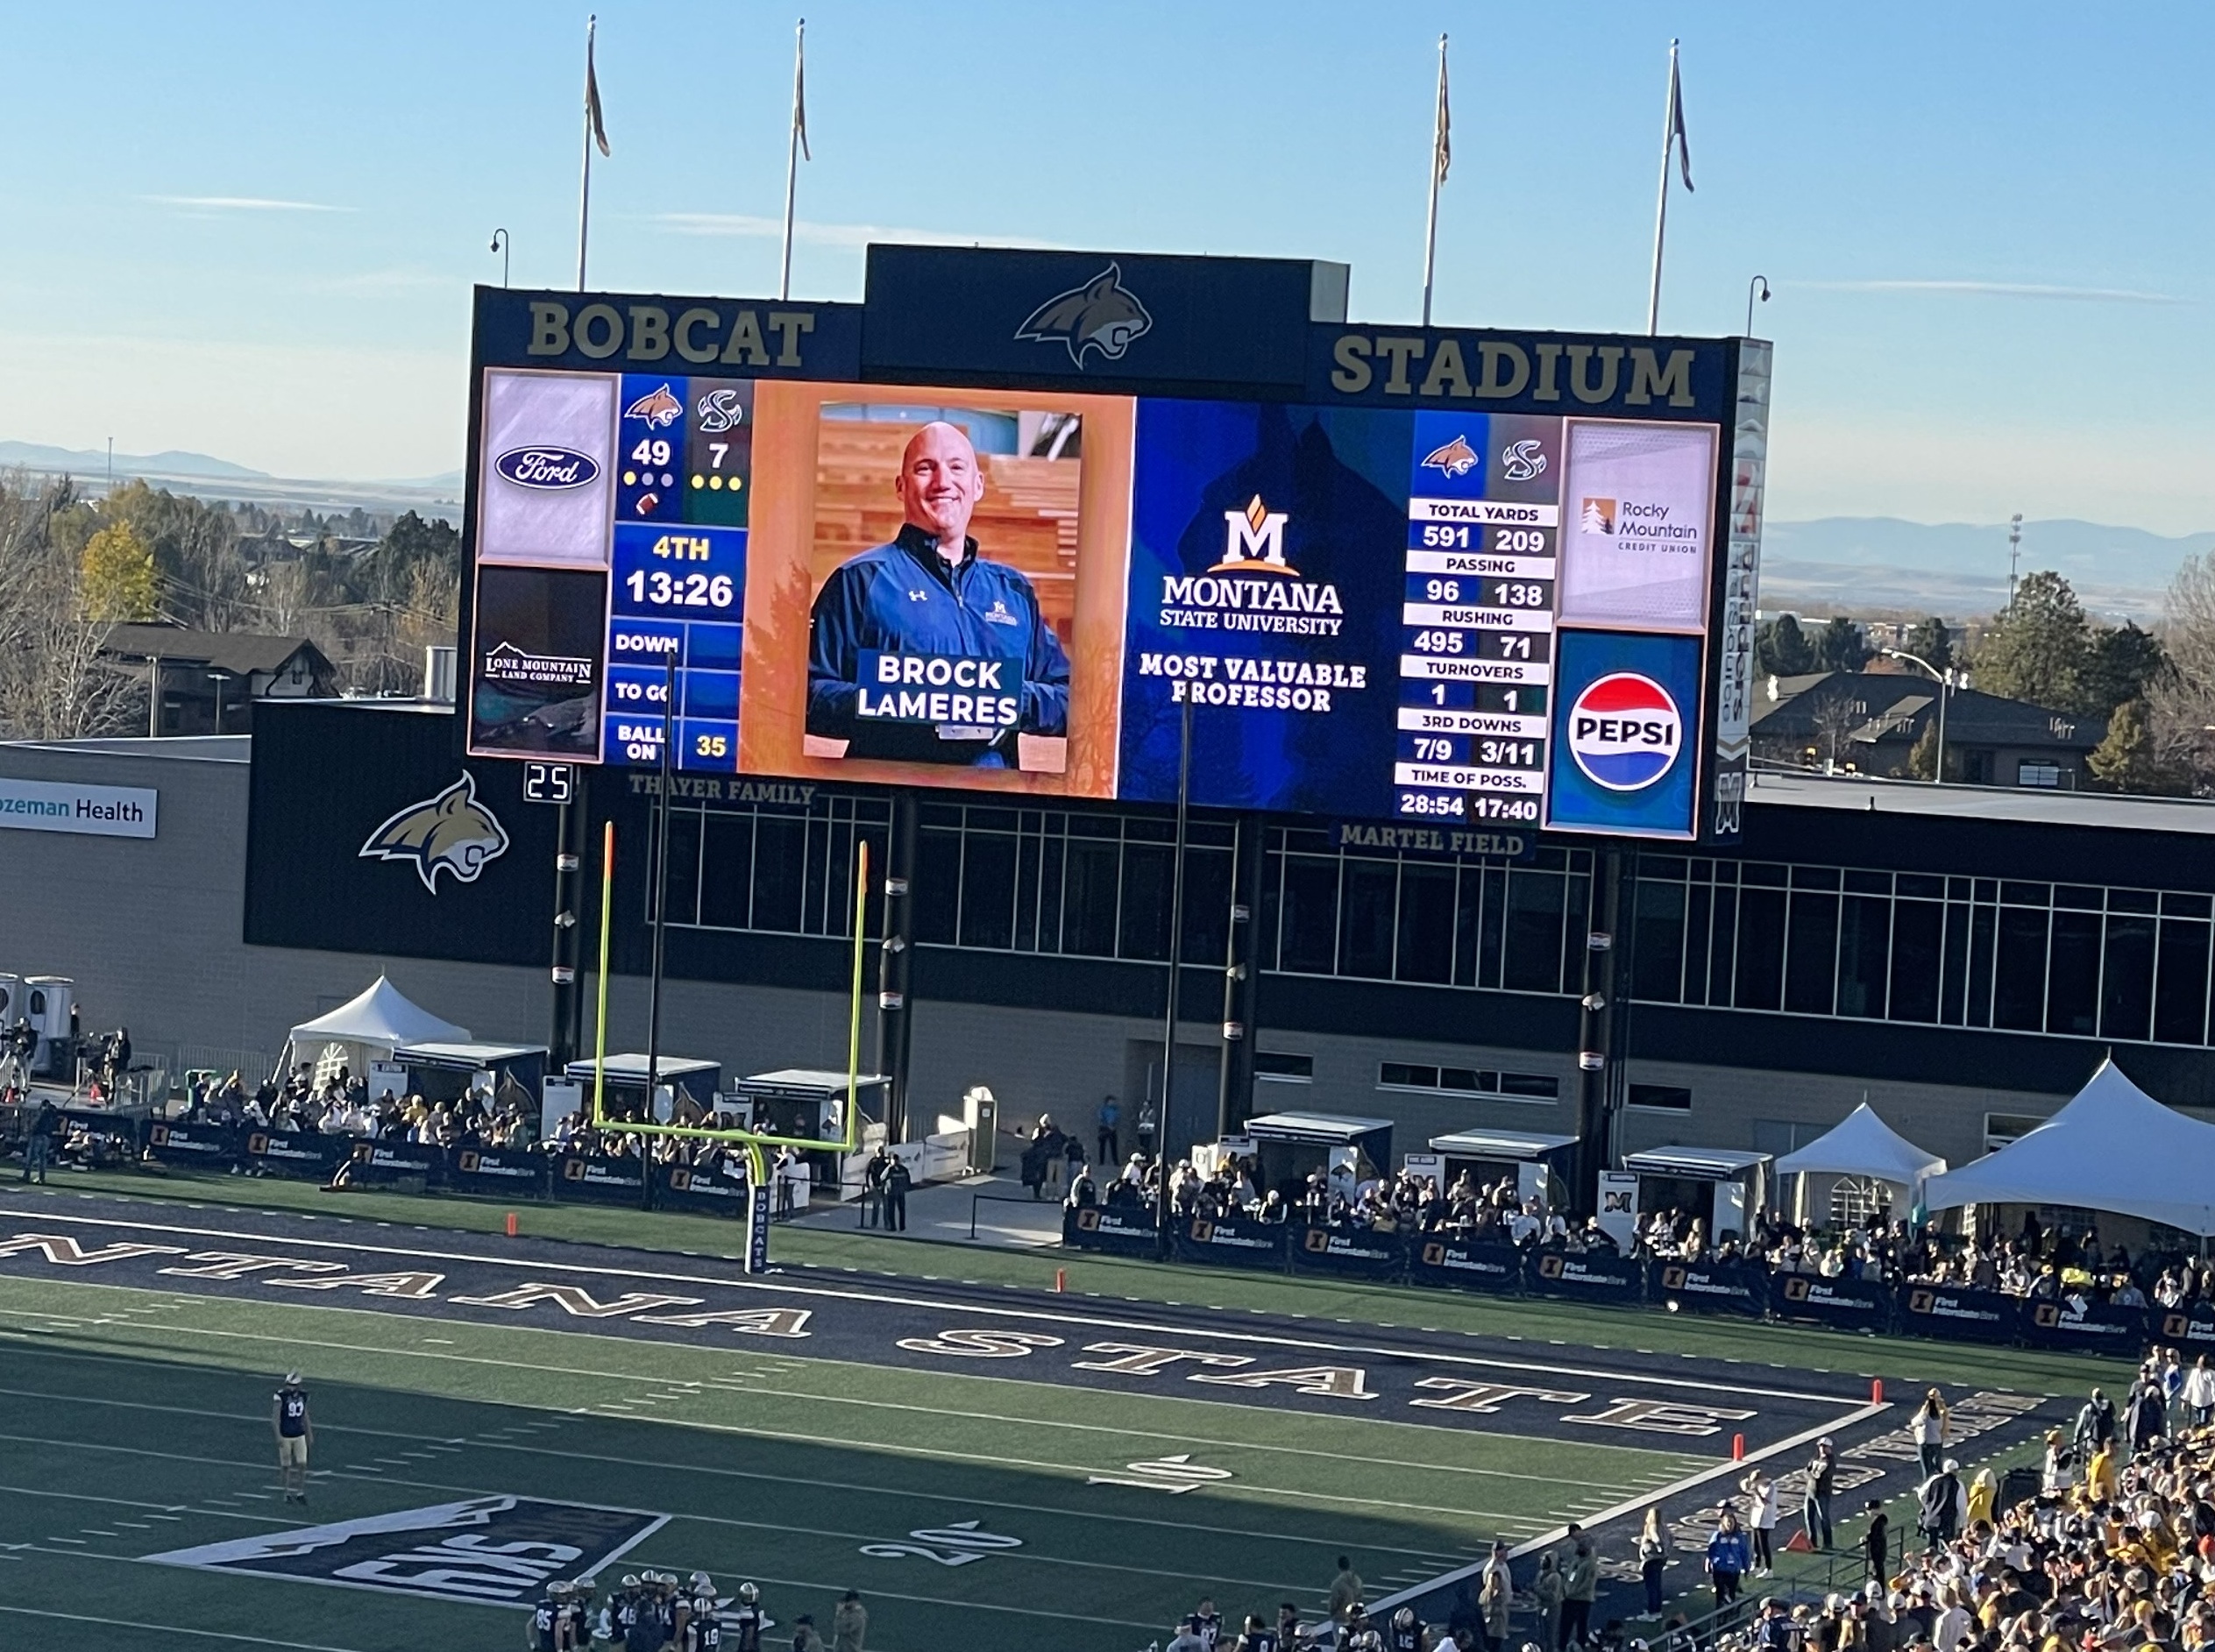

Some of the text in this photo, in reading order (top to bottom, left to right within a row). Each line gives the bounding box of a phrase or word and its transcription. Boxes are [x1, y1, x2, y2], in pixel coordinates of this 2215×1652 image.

[526, 302, 815, 367] BOBCAT
[1331, 335, 1696, 408] STADIUM
[632, 439, 671, 466] 49
[708, 443, 728, 469] 7
[515, 451, 580, 483] Ford
[1429, 504, 1539, 521] TOTAL YARDS
[1622, 501, 1670, 521] Rocky
[1423, 526, 1469, 548] 591
[1495, 529, 1544, 552] 209
[1619, 521, 1697, 539] Mountain
[653, 535, 709, 561] 4TH
[1618, 542, 1697, 554] CREDIT UNION
[1446, 557, 1516, 573] PASSING
[627, 570, 734, 607] 13:26
[1161, 576, 1344, 614] MONTANA
[1426, 579, 1459, 602] 96
[1494, 584, 1543, 606] 138
[1160, 609, 1343, 635] STATE UNIVERSITY
[1442, 610, 1514, 626] RUSHING
[615, 635, 678, 653] DOWN
[1414, 630, 1463, 653] 495
[1500, 636, 1531, 658] 71
[486, 657, 592, 678] LONE MOUNTAIN
[501, 670, 575, 683] LAND COMPANY
[878, 655, 1002, 690] BROCK
[1139, 653, 1367, 689] MOST VALUABLE
[1426, 662, 1523, 679] TURNOVERS
[615, 683, 642, 699] TO
[1171, 680, 1331, 712] PROFESSOR
[1431, 684, 1445, 705] 1
[1503, 690, 1517, 712] 1
[858, 688, 1018, 725] LAMERES
[618, 725, 665, 743] BALL
[1423, 715, 1522, 733] 3RD DOWNS
[1576, 717, 1674, 748] PEPSI
[627, 744, 656, 760] ON
[697, 735, 726, 757] 35
[1414, 738, 1452, 760] 7/9
[1480, 741, 1534, 765] 3/11
[528, 765, 568, 799] 25
[629, 774, 815, 805] THAYER FAMILY
[1412, 769, 1527, 788] TIME OF POSS.
[0, 798, 143, 822] zeman Health
[1401, 794, 1464, 816] 28:54
[1475, 798, 1537, 820] 17:40
[1340, 824, 1524, 855] MARTEL FIELD
[1605, 1191, 1632, 1213] M
[754, 1191, 766, 1268] BOBCATS
[895, 1329, 1757, 1436] STATE
[536, 1608, 552, 1631] 85
